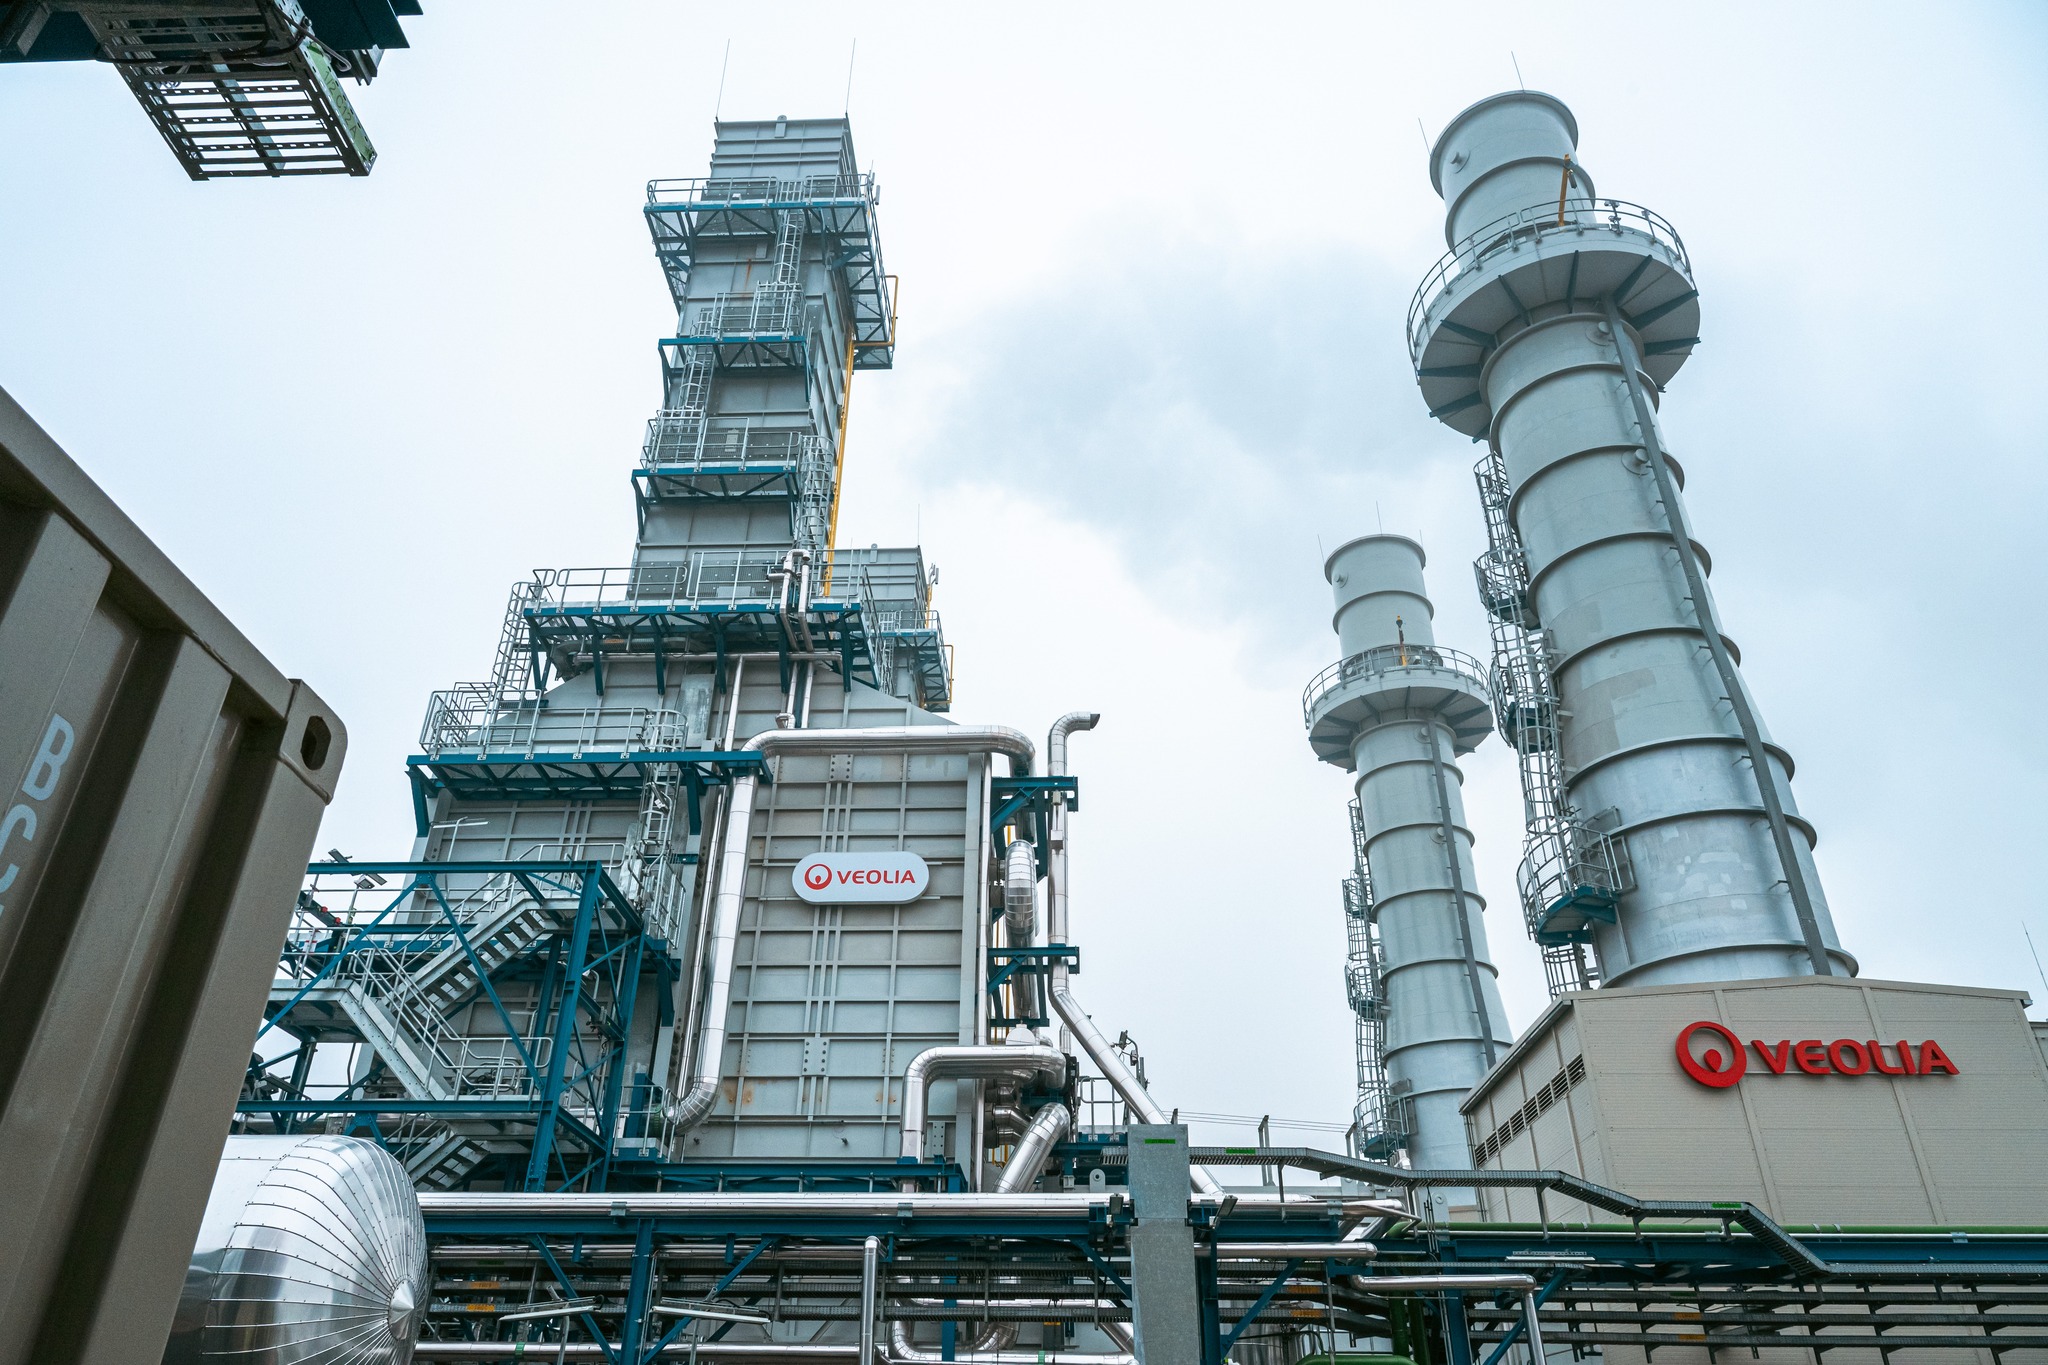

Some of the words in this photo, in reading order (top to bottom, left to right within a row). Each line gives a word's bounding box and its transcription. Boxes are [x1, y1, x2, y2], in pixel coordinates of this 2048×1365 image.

[0, 713, 75, 918] BC
[837, 869, 916, 885] VEOLIA
[1750, 1038, 1960, 1076] VEOLIA
